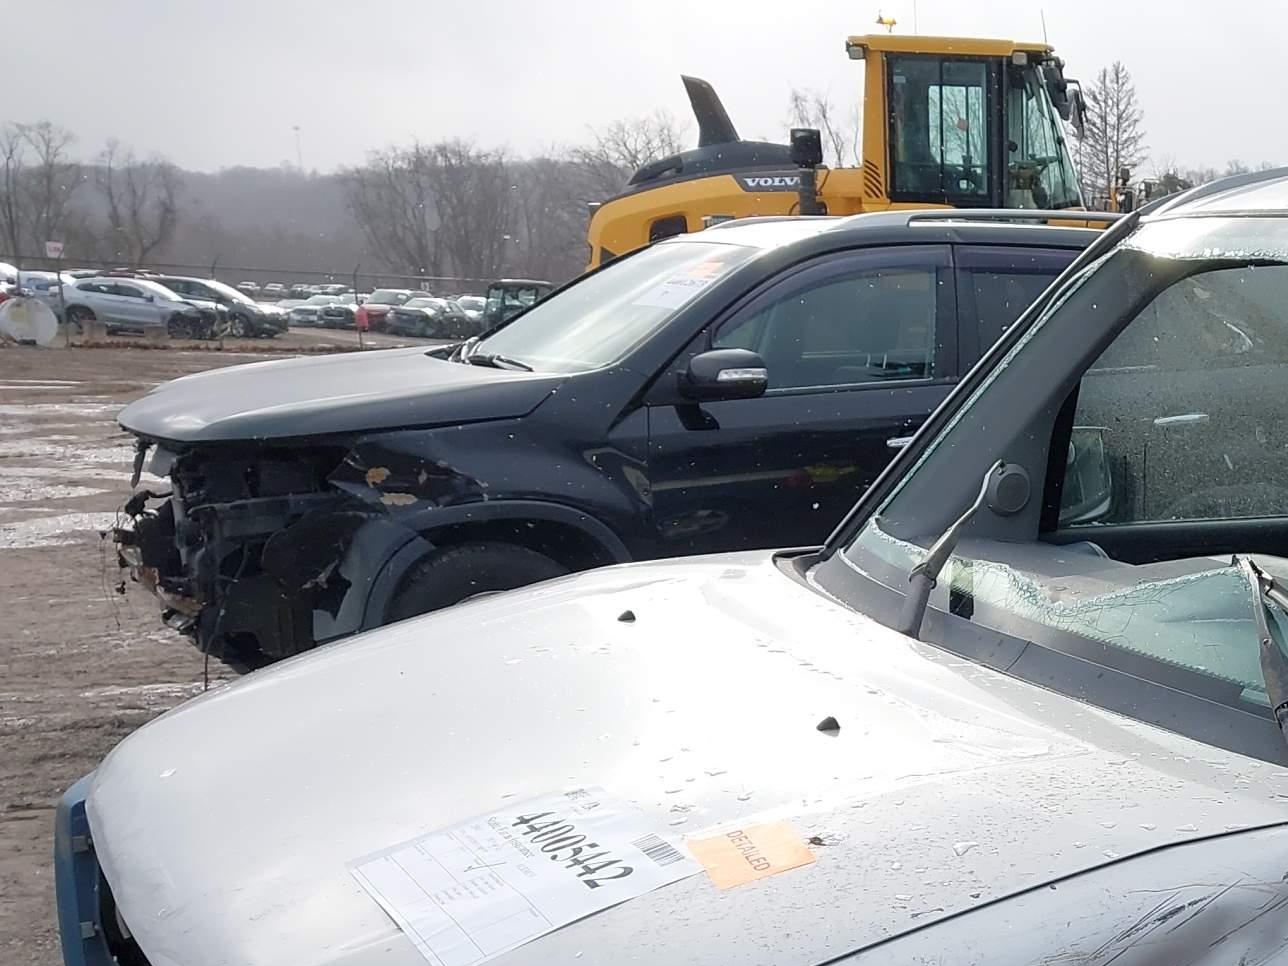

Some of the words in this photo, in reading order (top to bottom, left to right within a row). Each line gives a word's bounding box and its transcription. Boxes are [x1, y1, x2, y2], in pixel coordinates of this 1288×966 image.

[743, 176, 801, 187] VOLV
[511, 811, 634, 889] 44005442
[726, 830, 770, 871] DETAILED
